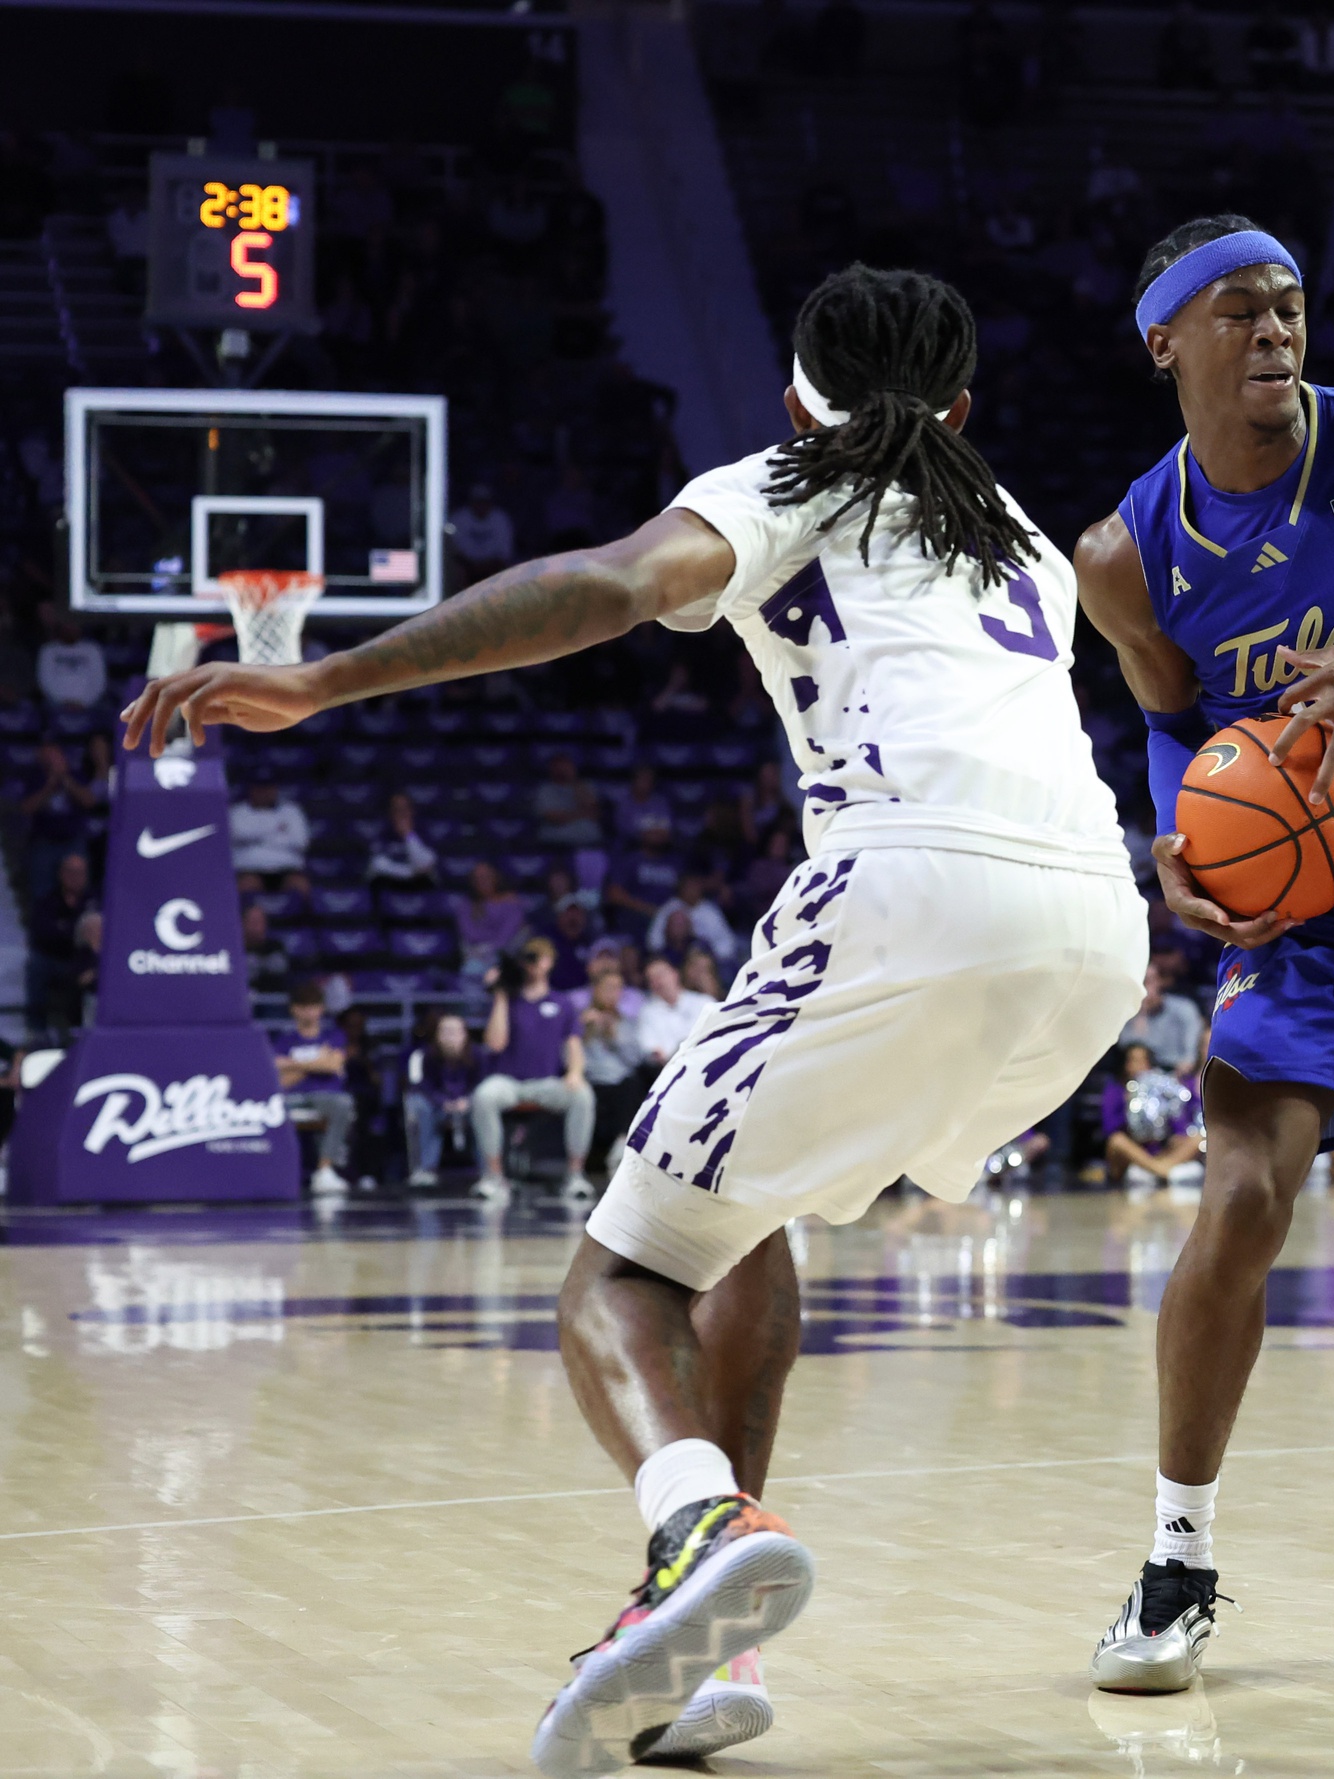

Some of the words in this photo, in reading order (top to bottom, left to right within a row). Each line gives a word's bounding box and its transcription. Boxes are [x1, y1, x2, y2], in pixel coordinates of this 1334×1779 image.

[200, 181, 290, 231] 2:38
[231, 231, 278, 309] 5
[1171, 565, 1192, 597] A
[128, 949, 231, 975] Channel
[73, 1073, 285, 1154] Dillons
